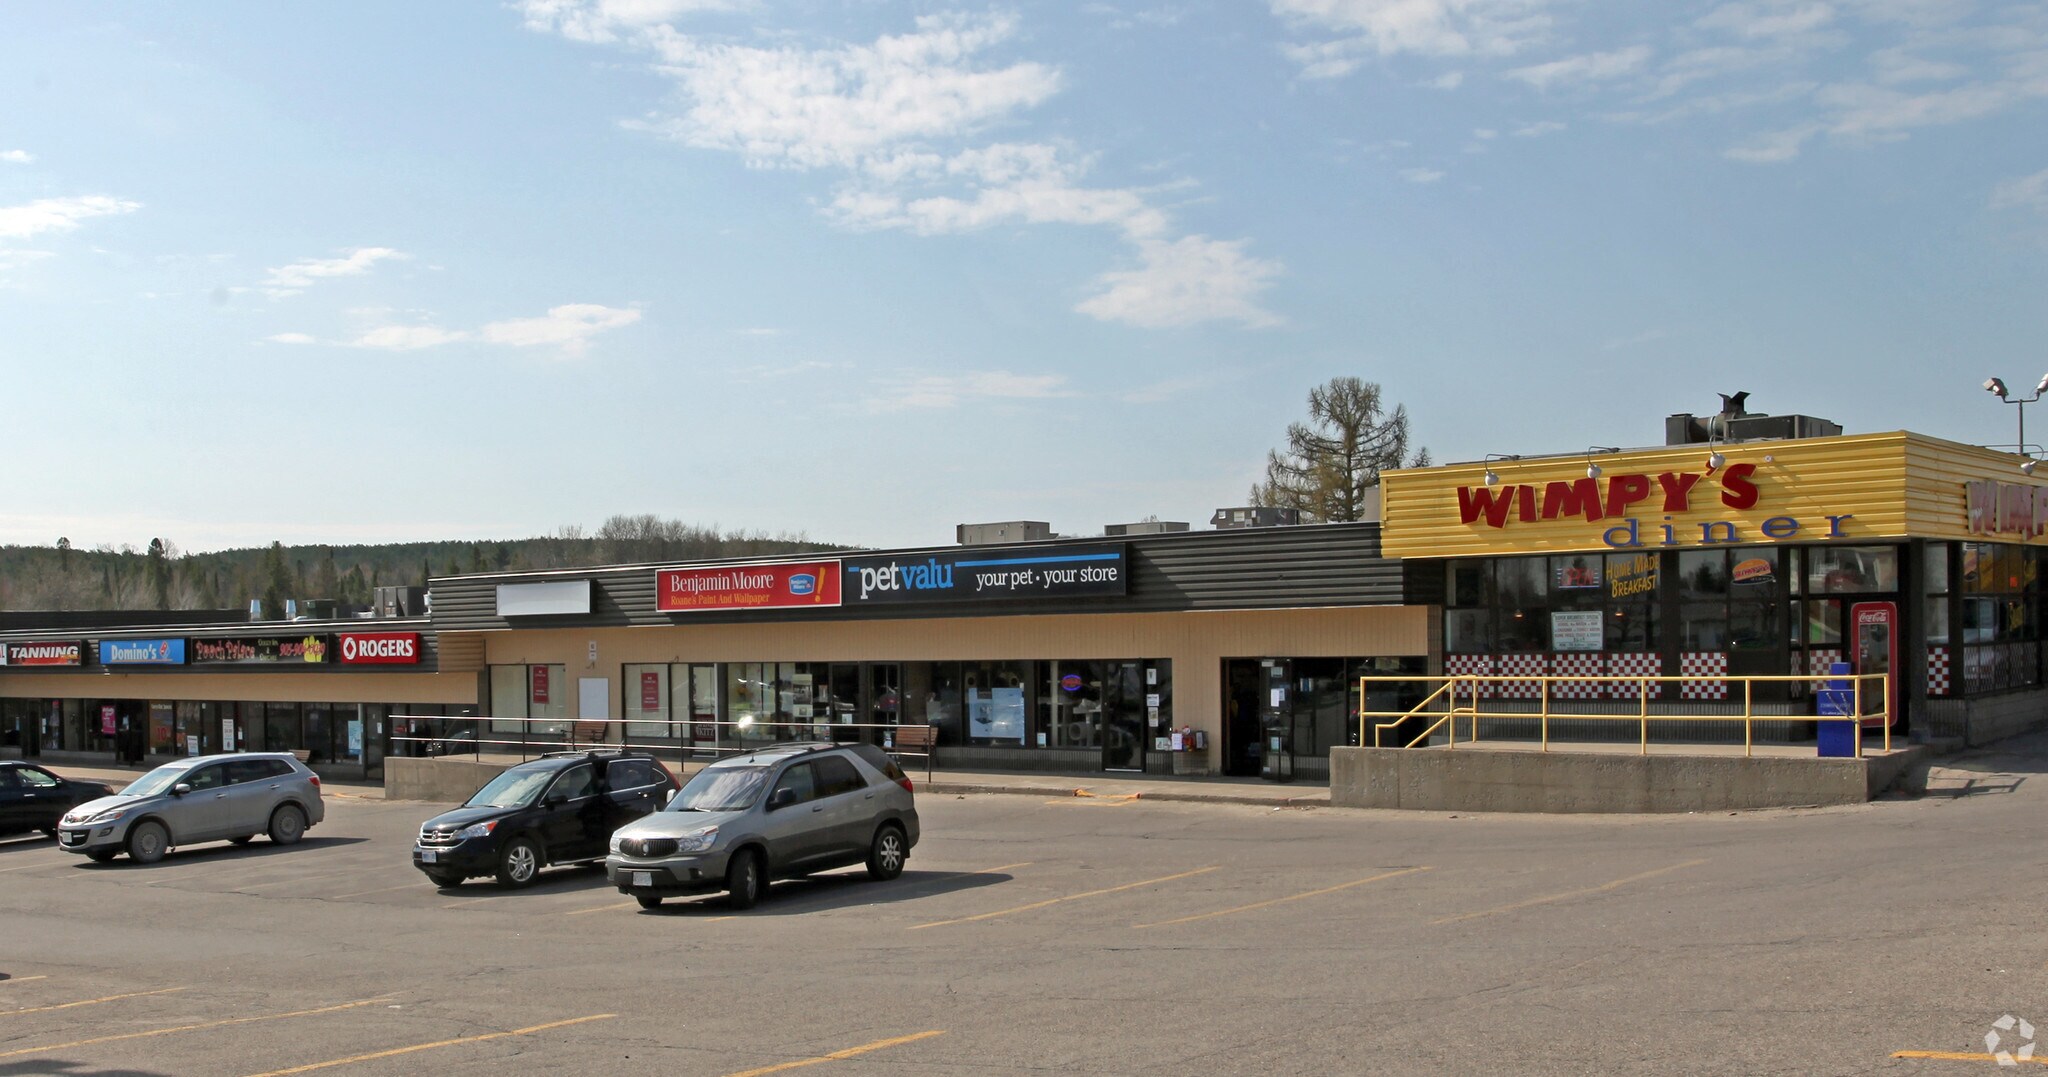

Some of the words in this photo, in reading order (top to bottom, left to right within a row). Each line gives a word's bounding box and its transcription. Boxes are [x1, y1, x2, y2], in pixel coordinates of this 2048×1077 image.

[1456, 459, 1761, 528] WIMPY'S
[1602, 514, 1853, 548] diner
[671, 573, 730, 595] Benjamin
[732, 571, 774, 589] Moore
[976, 571, 1008, 591] your
[1011, 568, 1033, 590] pet
[1043, 569, 1078, 589] your
[1080, 564, 1118, 582] store
[671, 594, 697, 606] Roane's
[698, 594, 717, 605] Paint
[719, 593, 733, 604] And
[734, 592, 770, 605] Wallpaper
[11, 646, 79, 659] TANNING
[111, 643, 157, 660] Domino's
[359, 639, 414, 657] ROGERS
